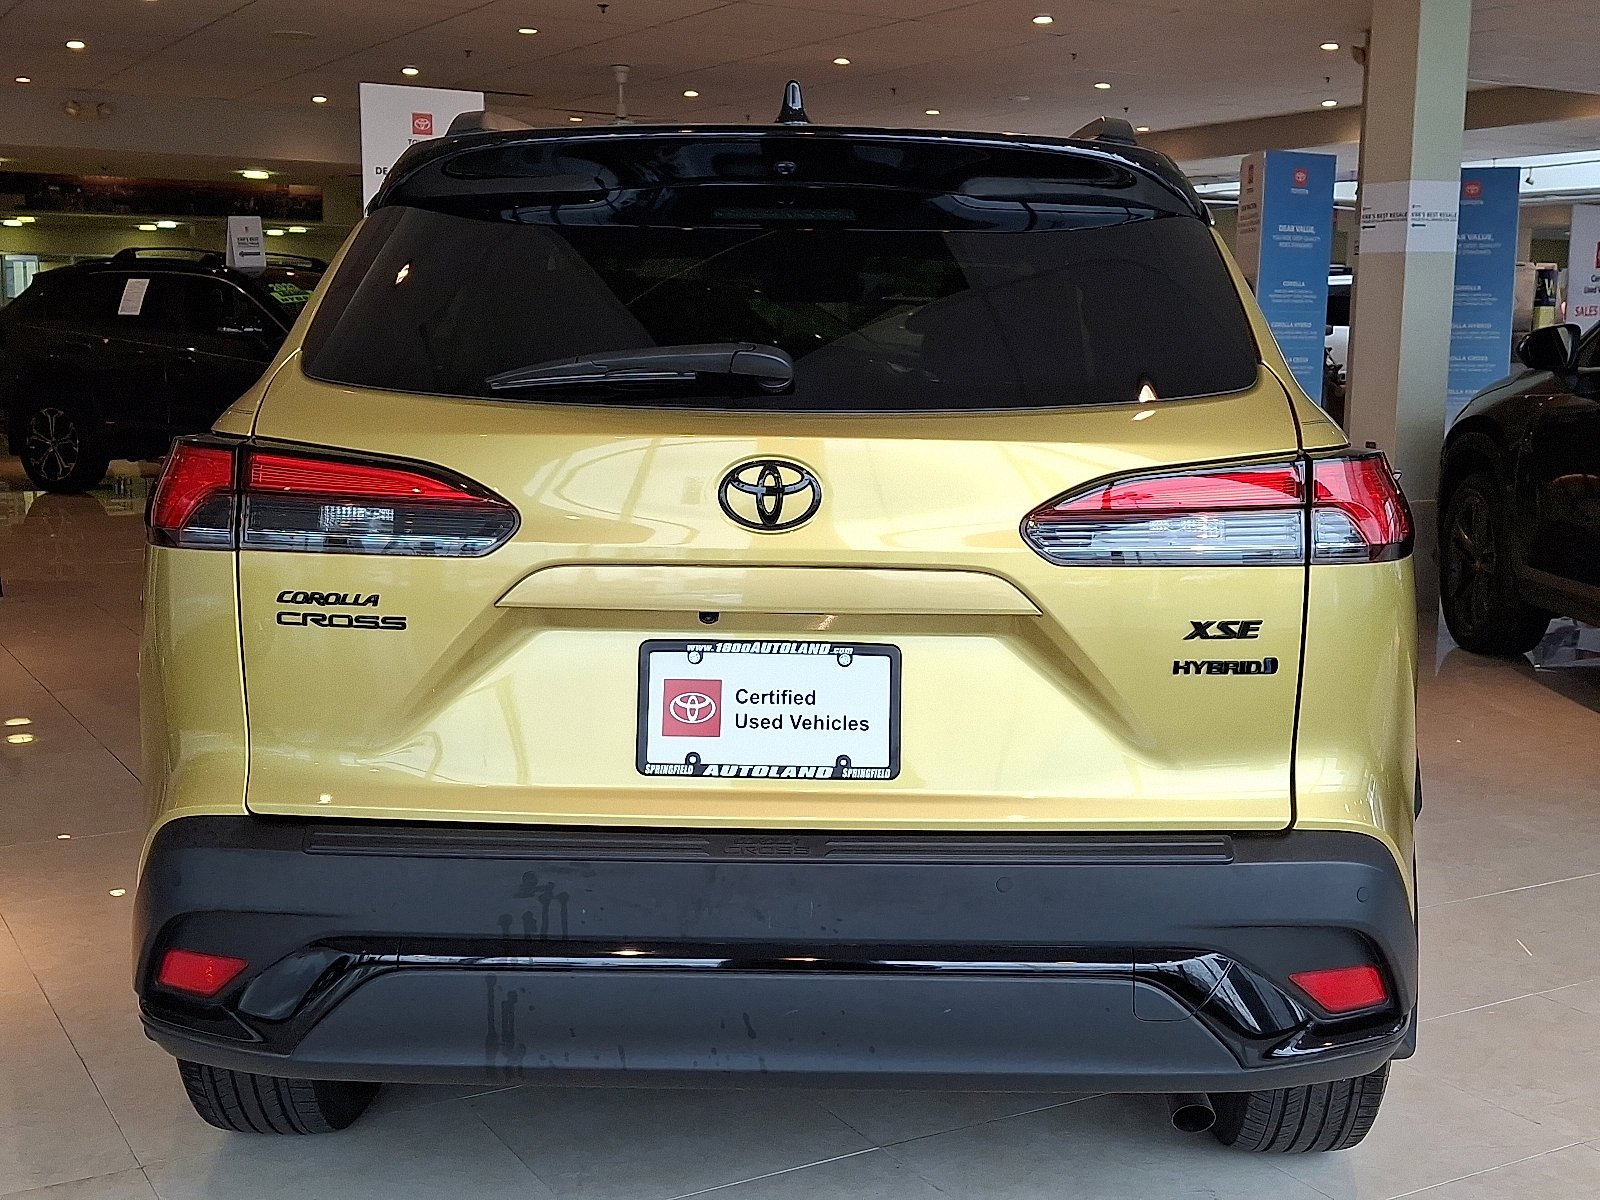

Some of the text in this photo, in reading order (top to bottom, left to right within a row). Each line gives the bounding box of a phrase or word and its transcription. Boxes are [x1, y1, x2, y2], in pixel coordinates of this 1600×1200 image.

[276, 590, 380, 607] COROLLA
[276, 611, 407, 630] CROSS
[1182, 619, 1263, 640] XSE
[1172, 660, 1262, 675] HYBRID
[735, 688, 816, 706] Certified
[735, 713, 870, 731] Used Vehicles
[645, 764, 694, 775] SPRINGFIELD
[702, 764, 834, 779] AUTOLAND
[842, 767, 891, 779] SPRINGFIELD
